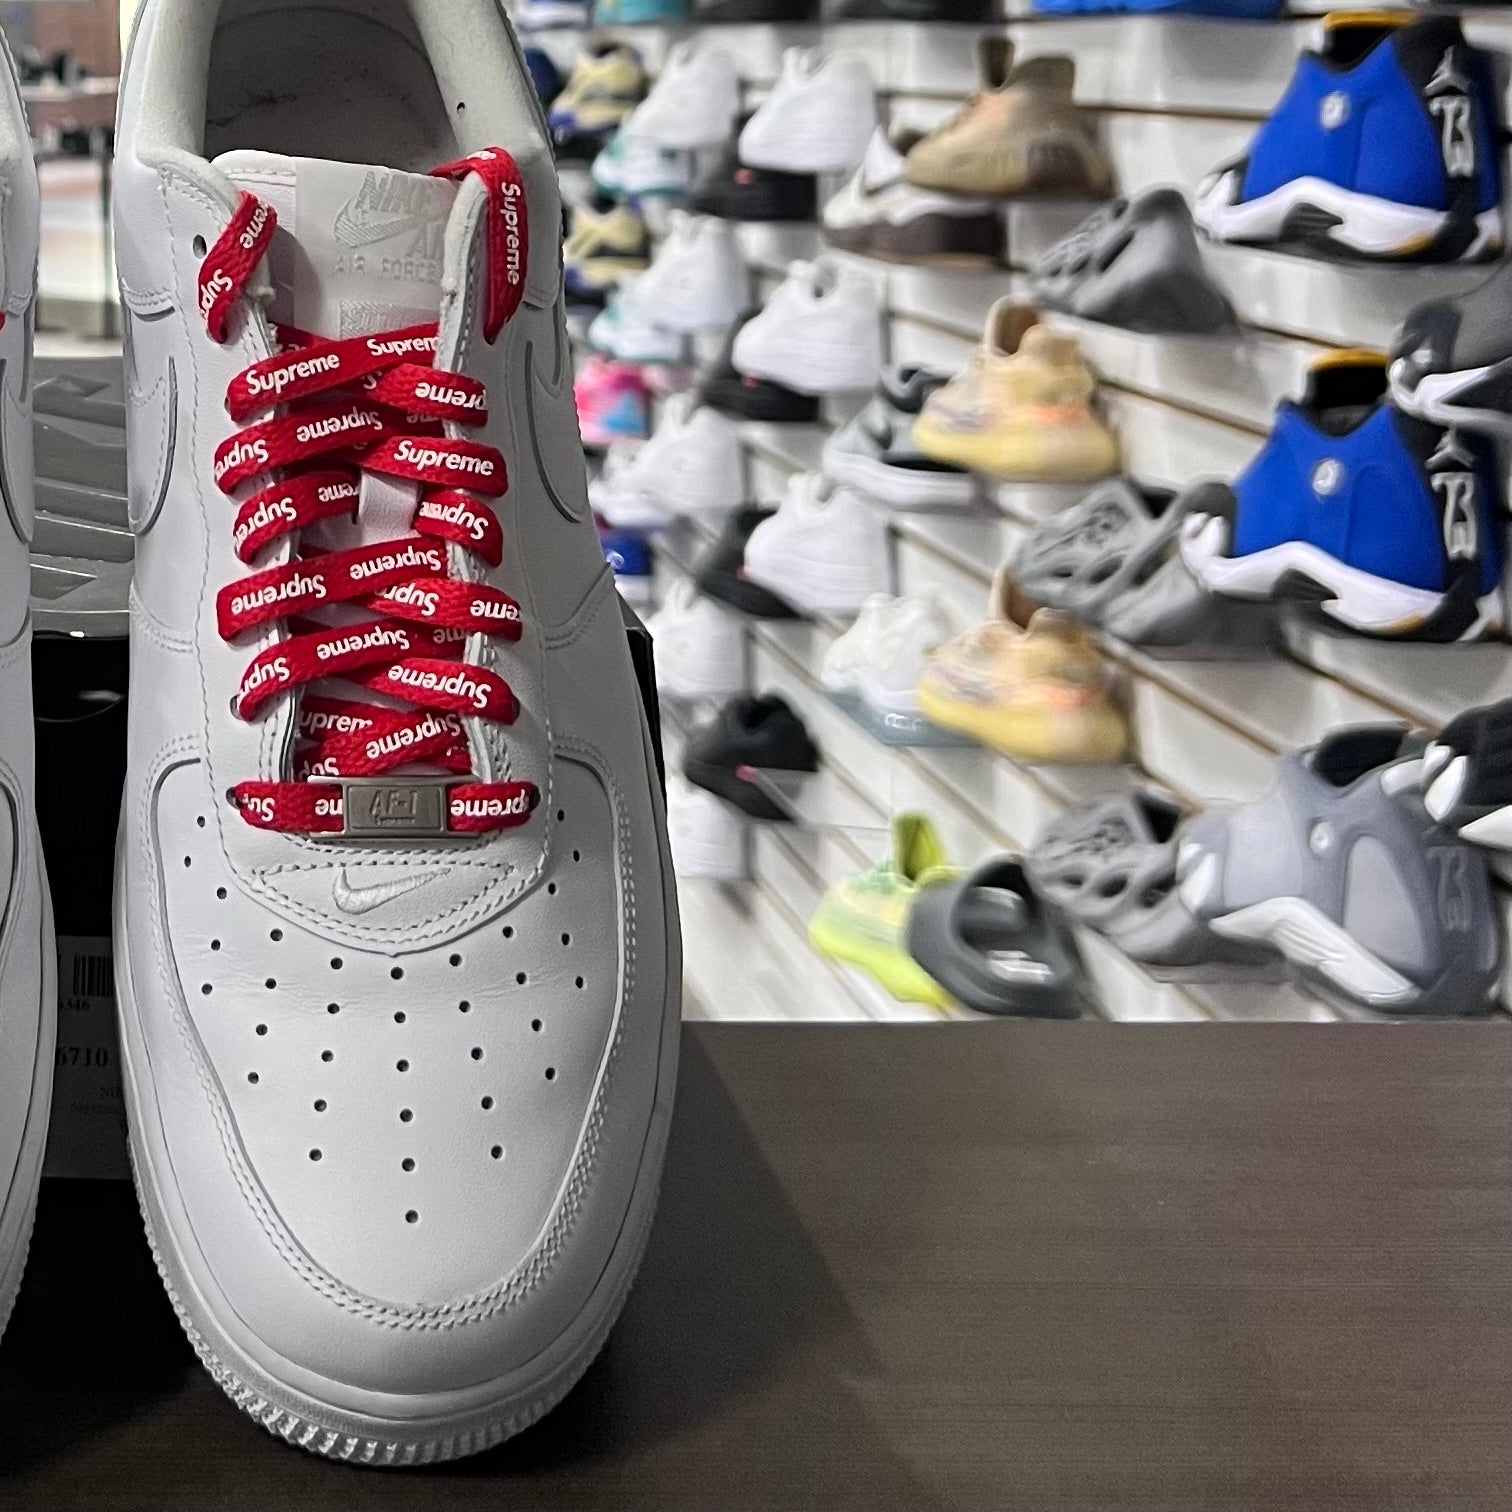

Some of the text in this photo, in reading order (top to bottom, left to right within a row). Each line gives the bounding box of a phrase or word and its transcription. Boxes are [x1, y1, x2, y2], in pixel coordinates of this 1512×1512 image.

[500, 181, 521, 286] Supreme
[246, 354, 340, 395] Supreme
[415, 382, 487, 410] preme
[296, 406, 383, 442] Supreme
[393, 440, 494, 476] Supreme
[350, 545, 442, 580] Supreme
[231, 573, 327, 615] Supreme
[317, 626, 410, 660] Supreme
[388, 665, 492, 708] Supreme
[366, 713, 461, 759] Supreme
[451, 789, 528, 817] preme
